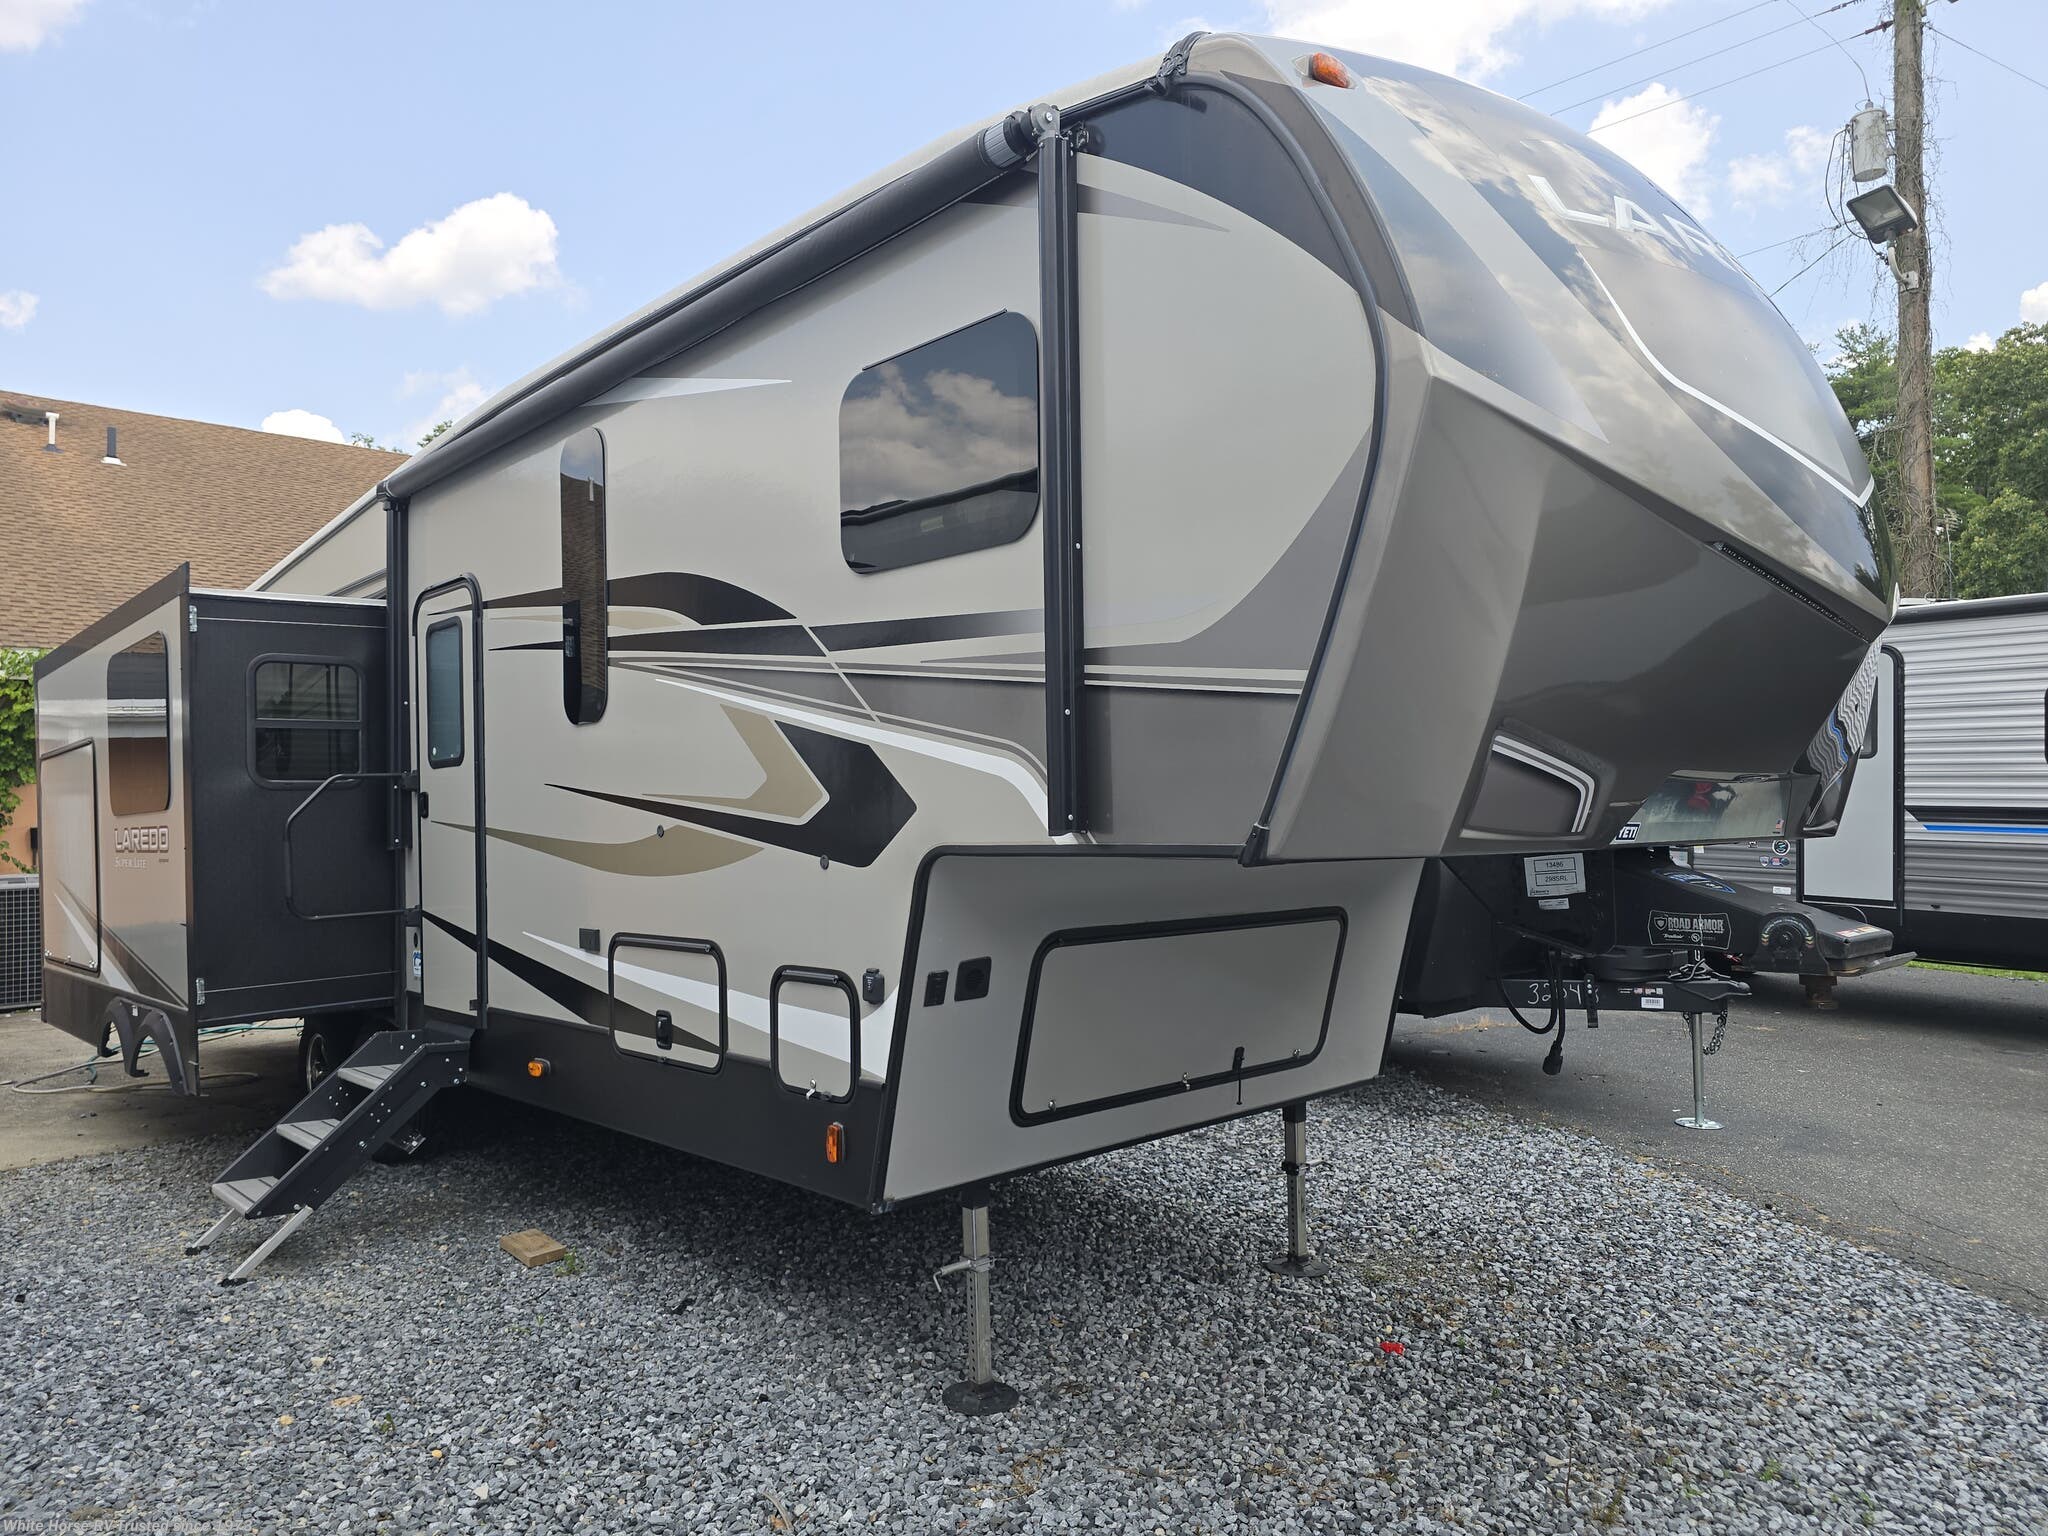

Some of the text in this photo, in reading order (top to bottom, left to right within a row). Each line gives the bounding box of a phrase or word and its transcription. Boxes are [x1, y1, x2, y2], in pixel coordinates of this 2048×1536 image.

[114, 825, 169, 853] LAREDO
[1667, 917, 1724, 932] ROAD ARMOR
